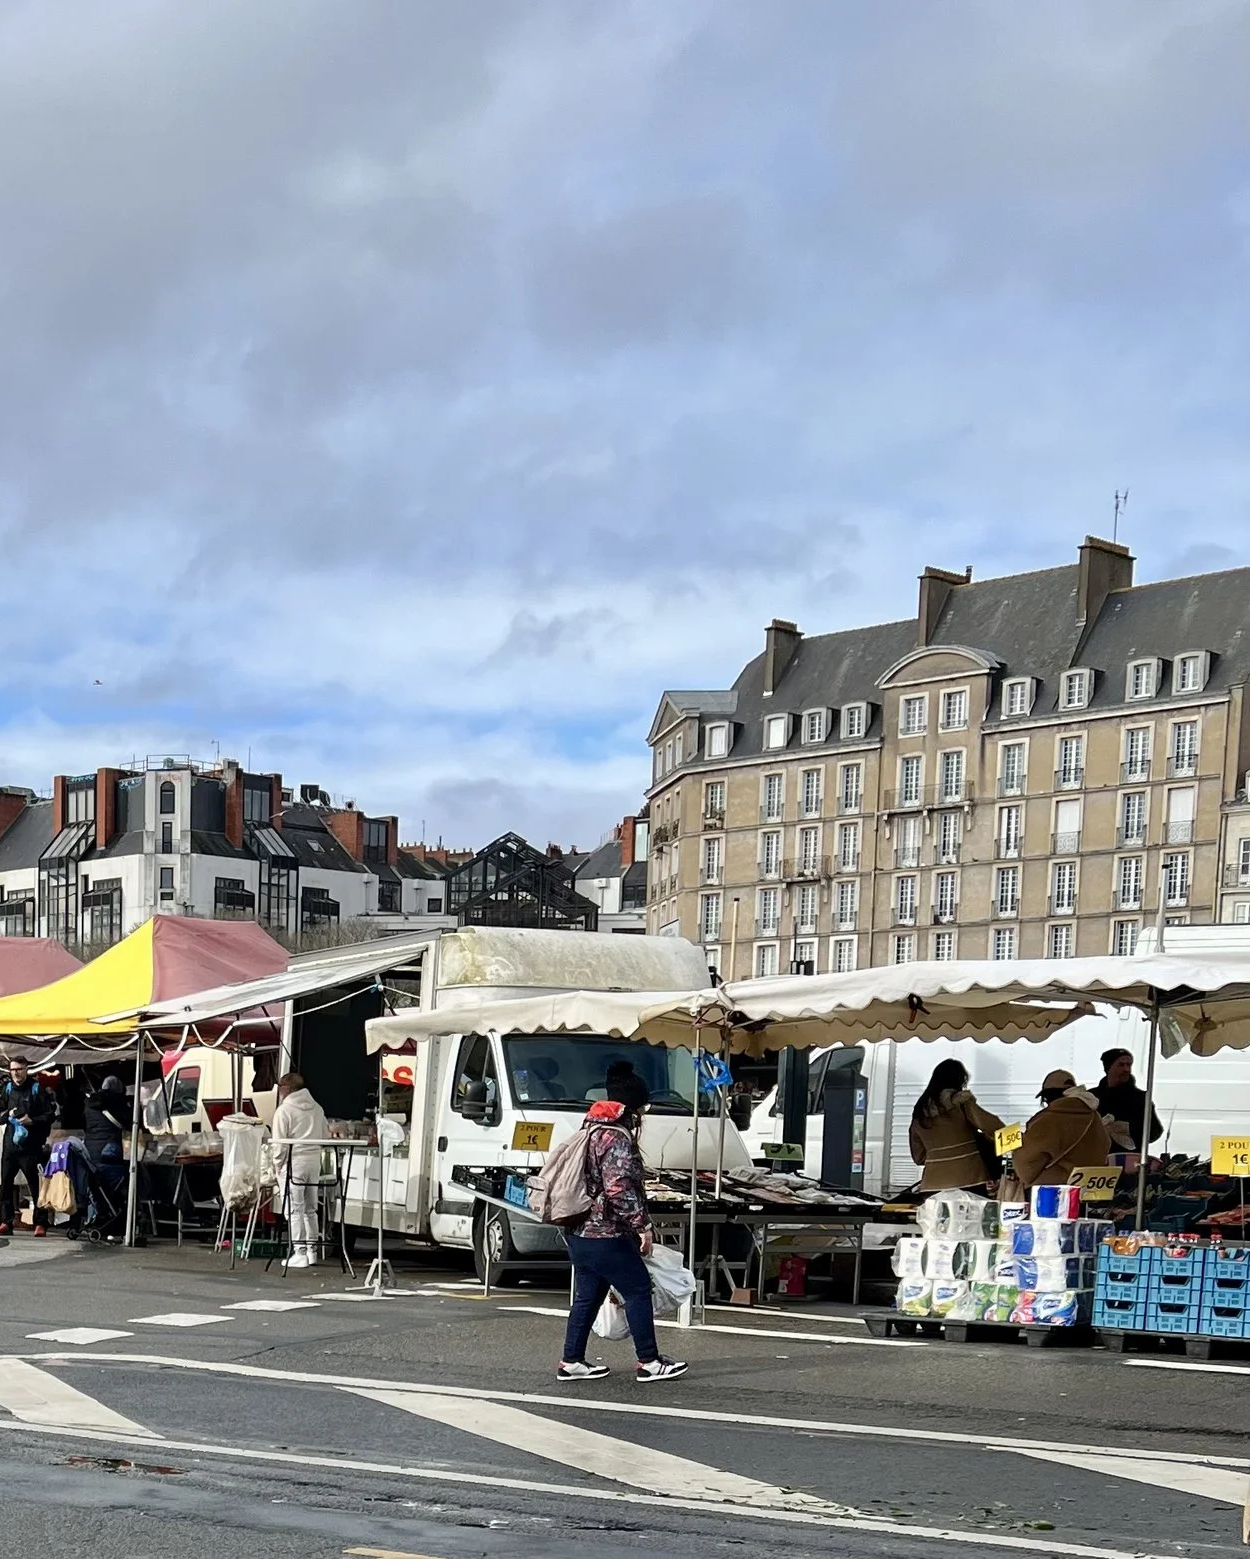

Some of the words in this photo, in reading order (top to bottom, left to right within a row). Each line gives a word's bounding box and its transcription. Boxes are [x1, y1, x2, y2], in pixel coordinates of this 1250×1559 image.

[1232, 1154, 1249, 1164] 1€
[1070, 1172, 1084, 1186] 2
[1087, 1176, 1117, 1189] 50€
